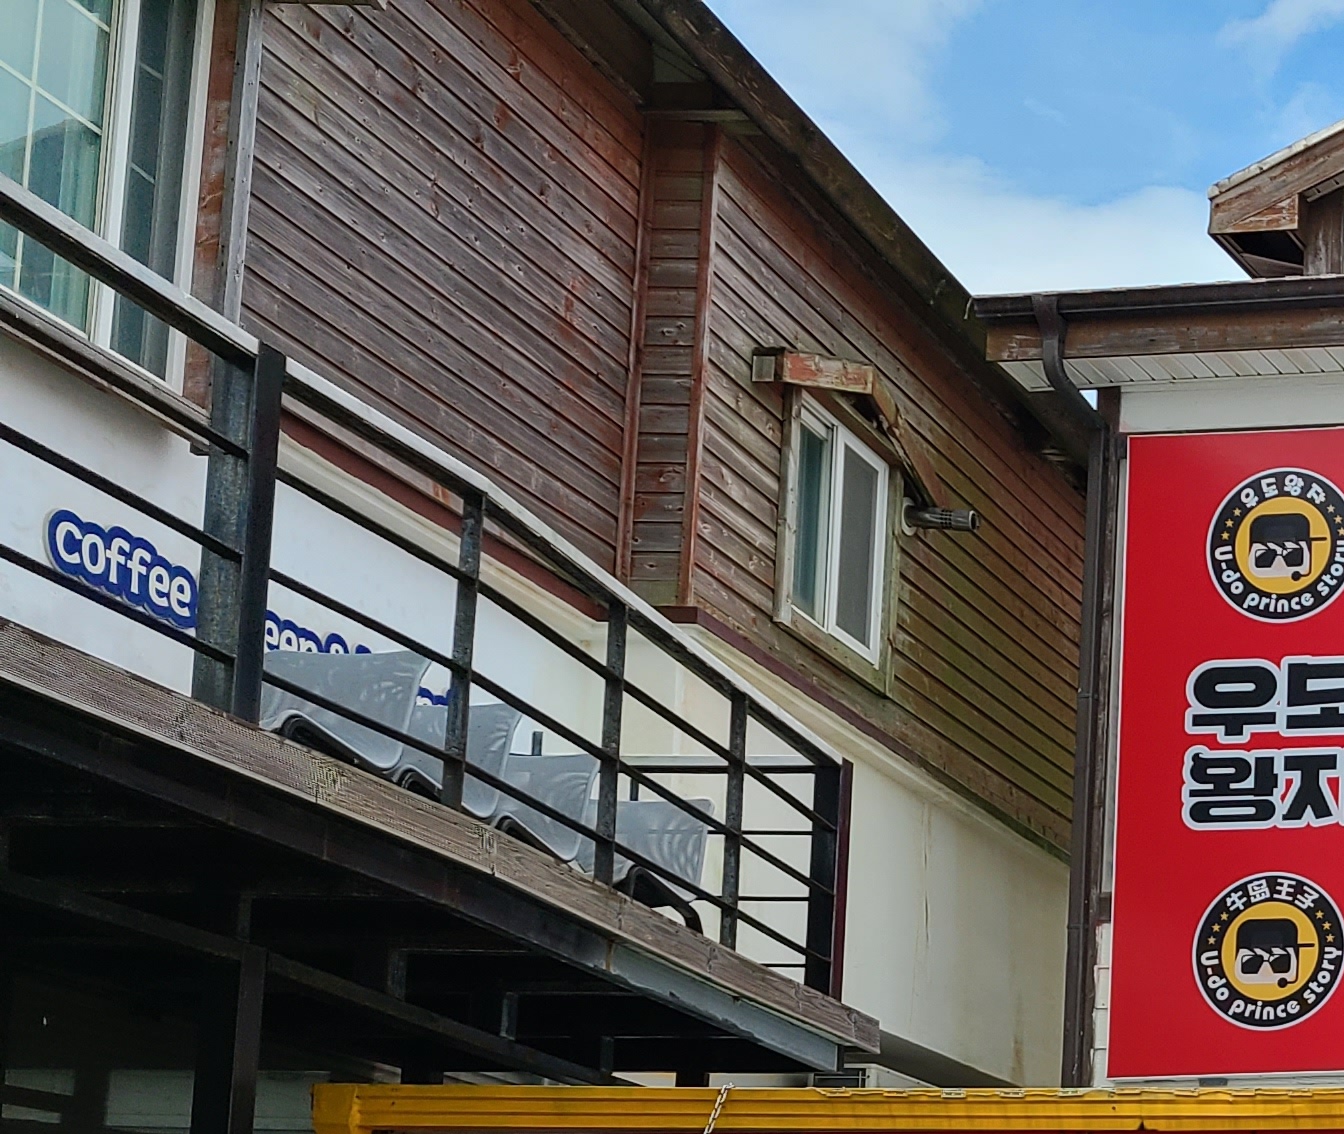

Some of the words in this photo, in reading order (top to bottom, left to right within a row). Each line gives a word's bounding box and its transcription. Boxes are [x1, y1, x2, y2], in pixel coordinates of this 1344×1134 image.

[1239, 475, 1326, 509] 우도왕자
[55, 521, 192, 617] coffee
[1212, 544, 1245, 597] U-do
[1243, 588, 1317, 615] prince
[1199, 951, 1231, 1005] U-do
[1228, 997, 1302, 1022] prince
[1301, 945, 1343, 1008] story
